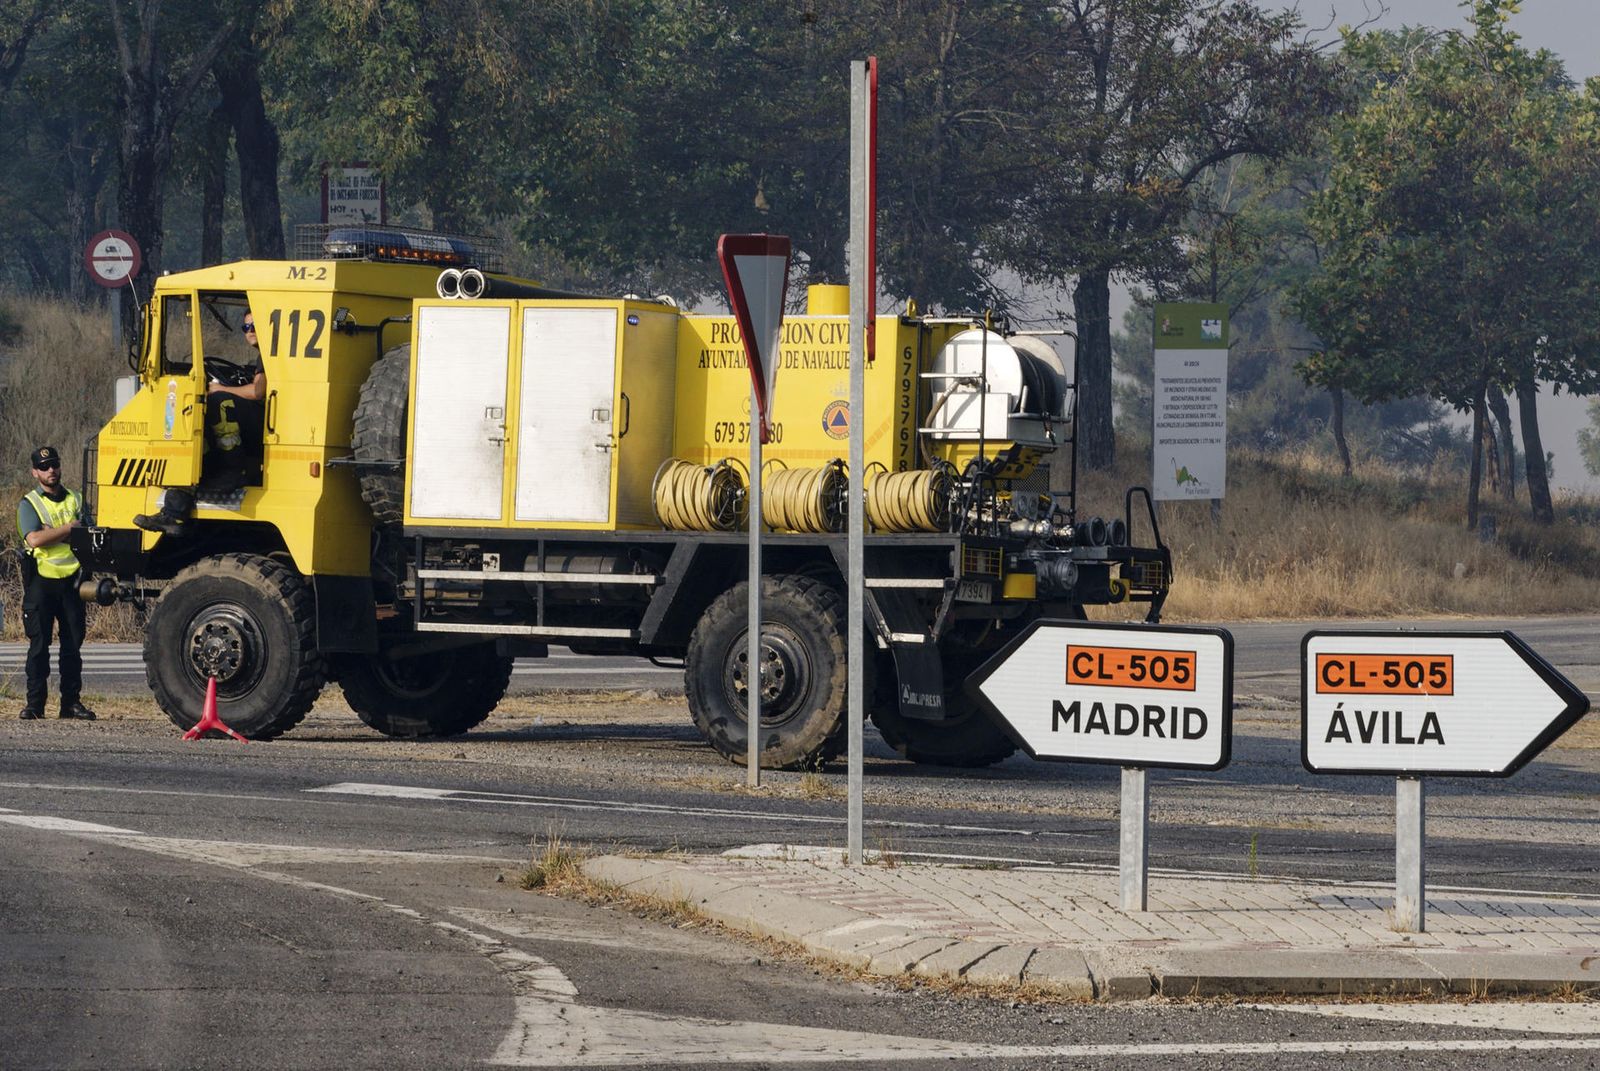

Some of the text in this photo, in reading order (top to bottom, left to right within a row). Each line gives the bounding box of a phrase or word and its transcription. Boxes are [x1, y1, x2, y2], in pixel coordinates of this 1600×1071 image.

[286, 266, 327, 281] M-2
[269, 309, 326, 359] 112
[785, 350, 799, 370] DE
[715, 421, 735, 443] 679
[1072, 651, 1191, 685] CL-505
[1322, 660, 1447, 690] CL-505
[1051, 699, 1208, 741] MADRID
[1325, 702, 1446, 745] ÁVILA
